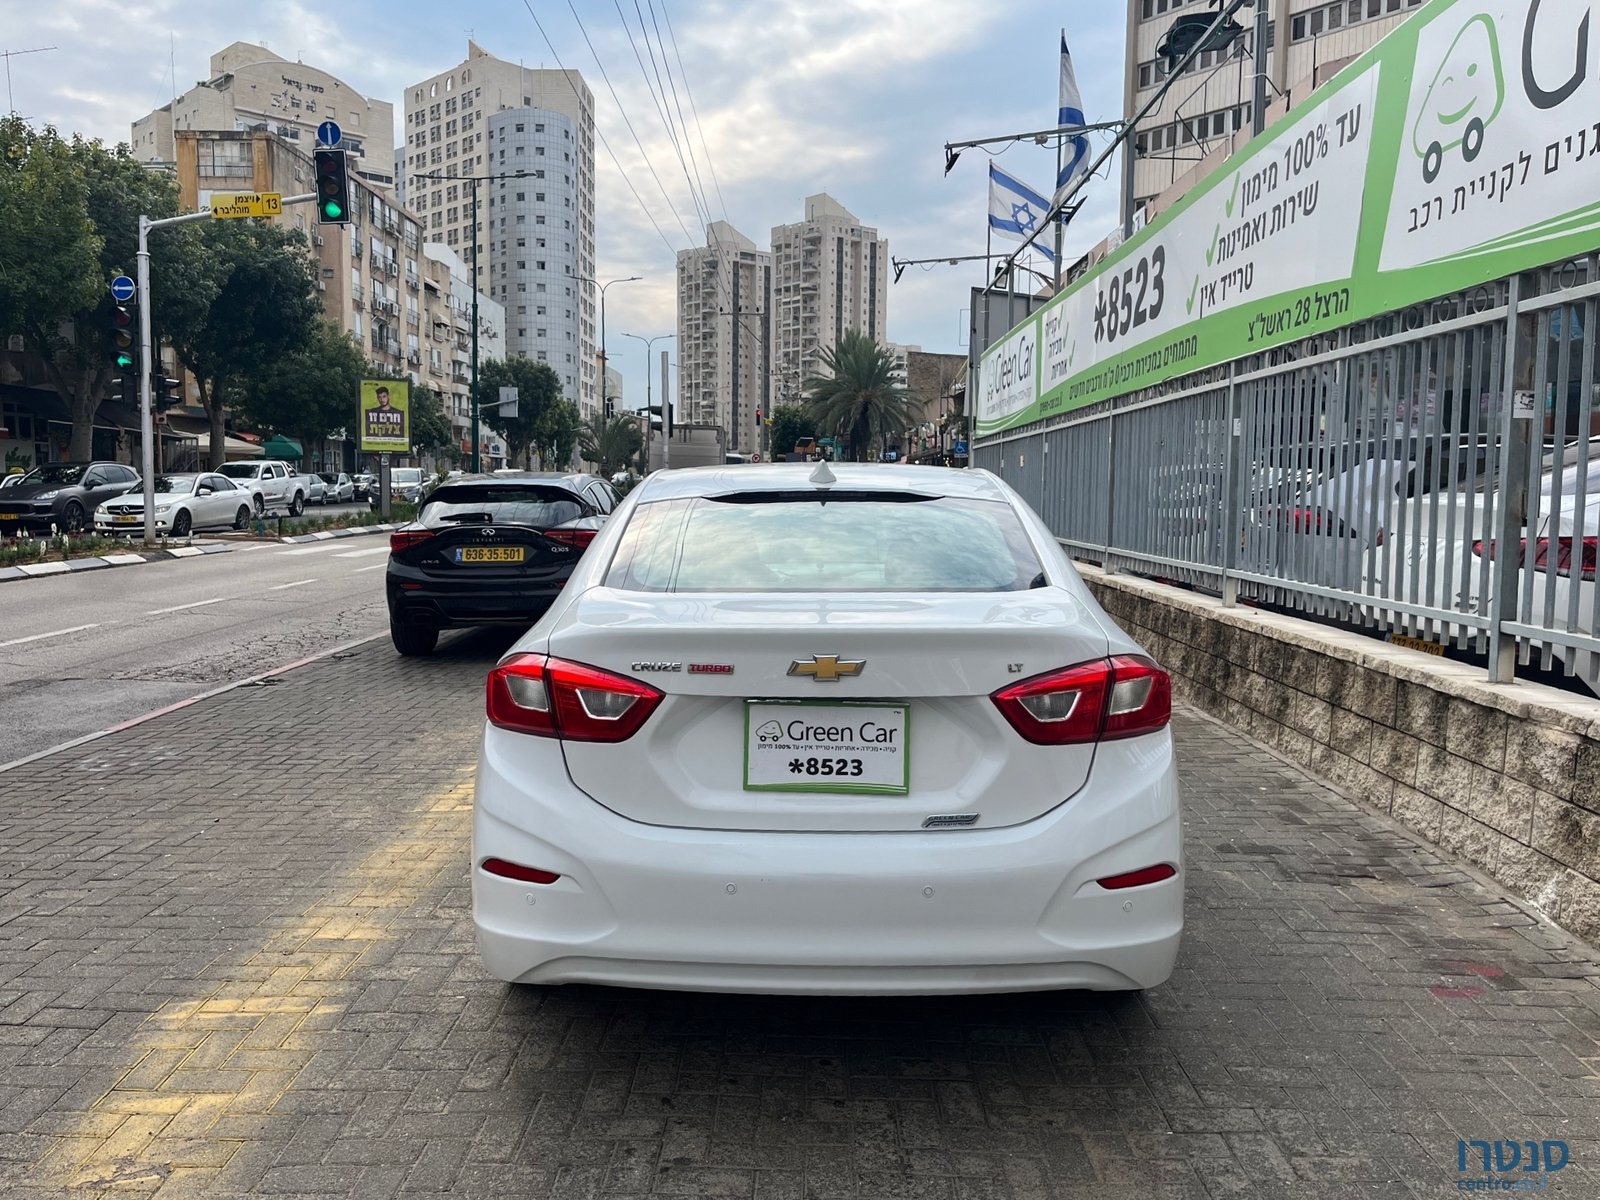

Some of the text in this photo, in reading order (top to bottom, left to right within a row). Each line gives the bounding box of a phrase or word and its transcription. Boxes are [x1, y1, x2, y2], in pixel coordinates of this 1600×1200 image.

[1241, 104, 1361, 218] עד 100% מימון
[1451, 150, 1532, 214] לקניית
[220, 205, 250, 215] מוהליבר
[234, 195, 255, 206] ויצמן
[266, 198, 278, 210] 13
[1408, 196, 1443, 233] רכב
[1217, 180, 1319, 264] שירות ואמינות
[1200, 262, 1254, 319] טרייד אין
[1315, 288, 1350, 320] הרצל
[1295, 299, 1310, 327] 28
[995, 336, 1034, 394] Green Car
[1135, 351, 1162, 378] במכירת
[1163, 335, 1198, 367] מתמחים
[1121, 361, 1134, 382] רכבי
[631, 661, 733, 673] CRUZE TURBO
[1007, 663, 1024, 673] LT
[787, 720, 897, 743] Green Car
